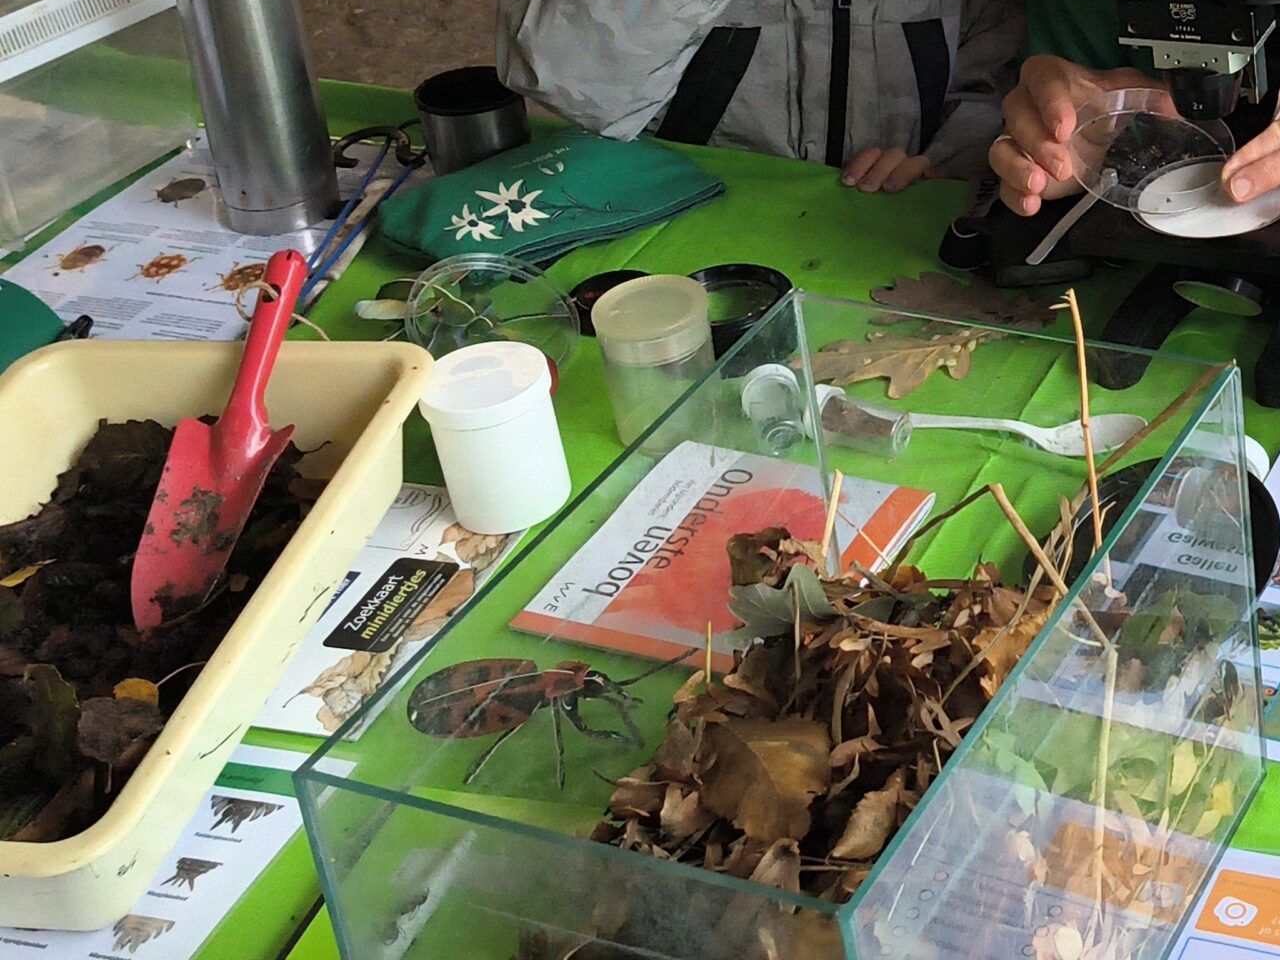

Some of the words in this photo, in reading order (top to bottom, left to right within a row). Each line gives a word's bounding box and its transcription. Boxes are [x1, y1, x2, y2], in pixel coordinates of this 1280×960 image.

[647, 468, 753, 569] Onderste
[581, 523, 673, 599] boven
[344, 573, 404, 632] Zoekkaart
[360, 568, 427, 640] minidiertjes
